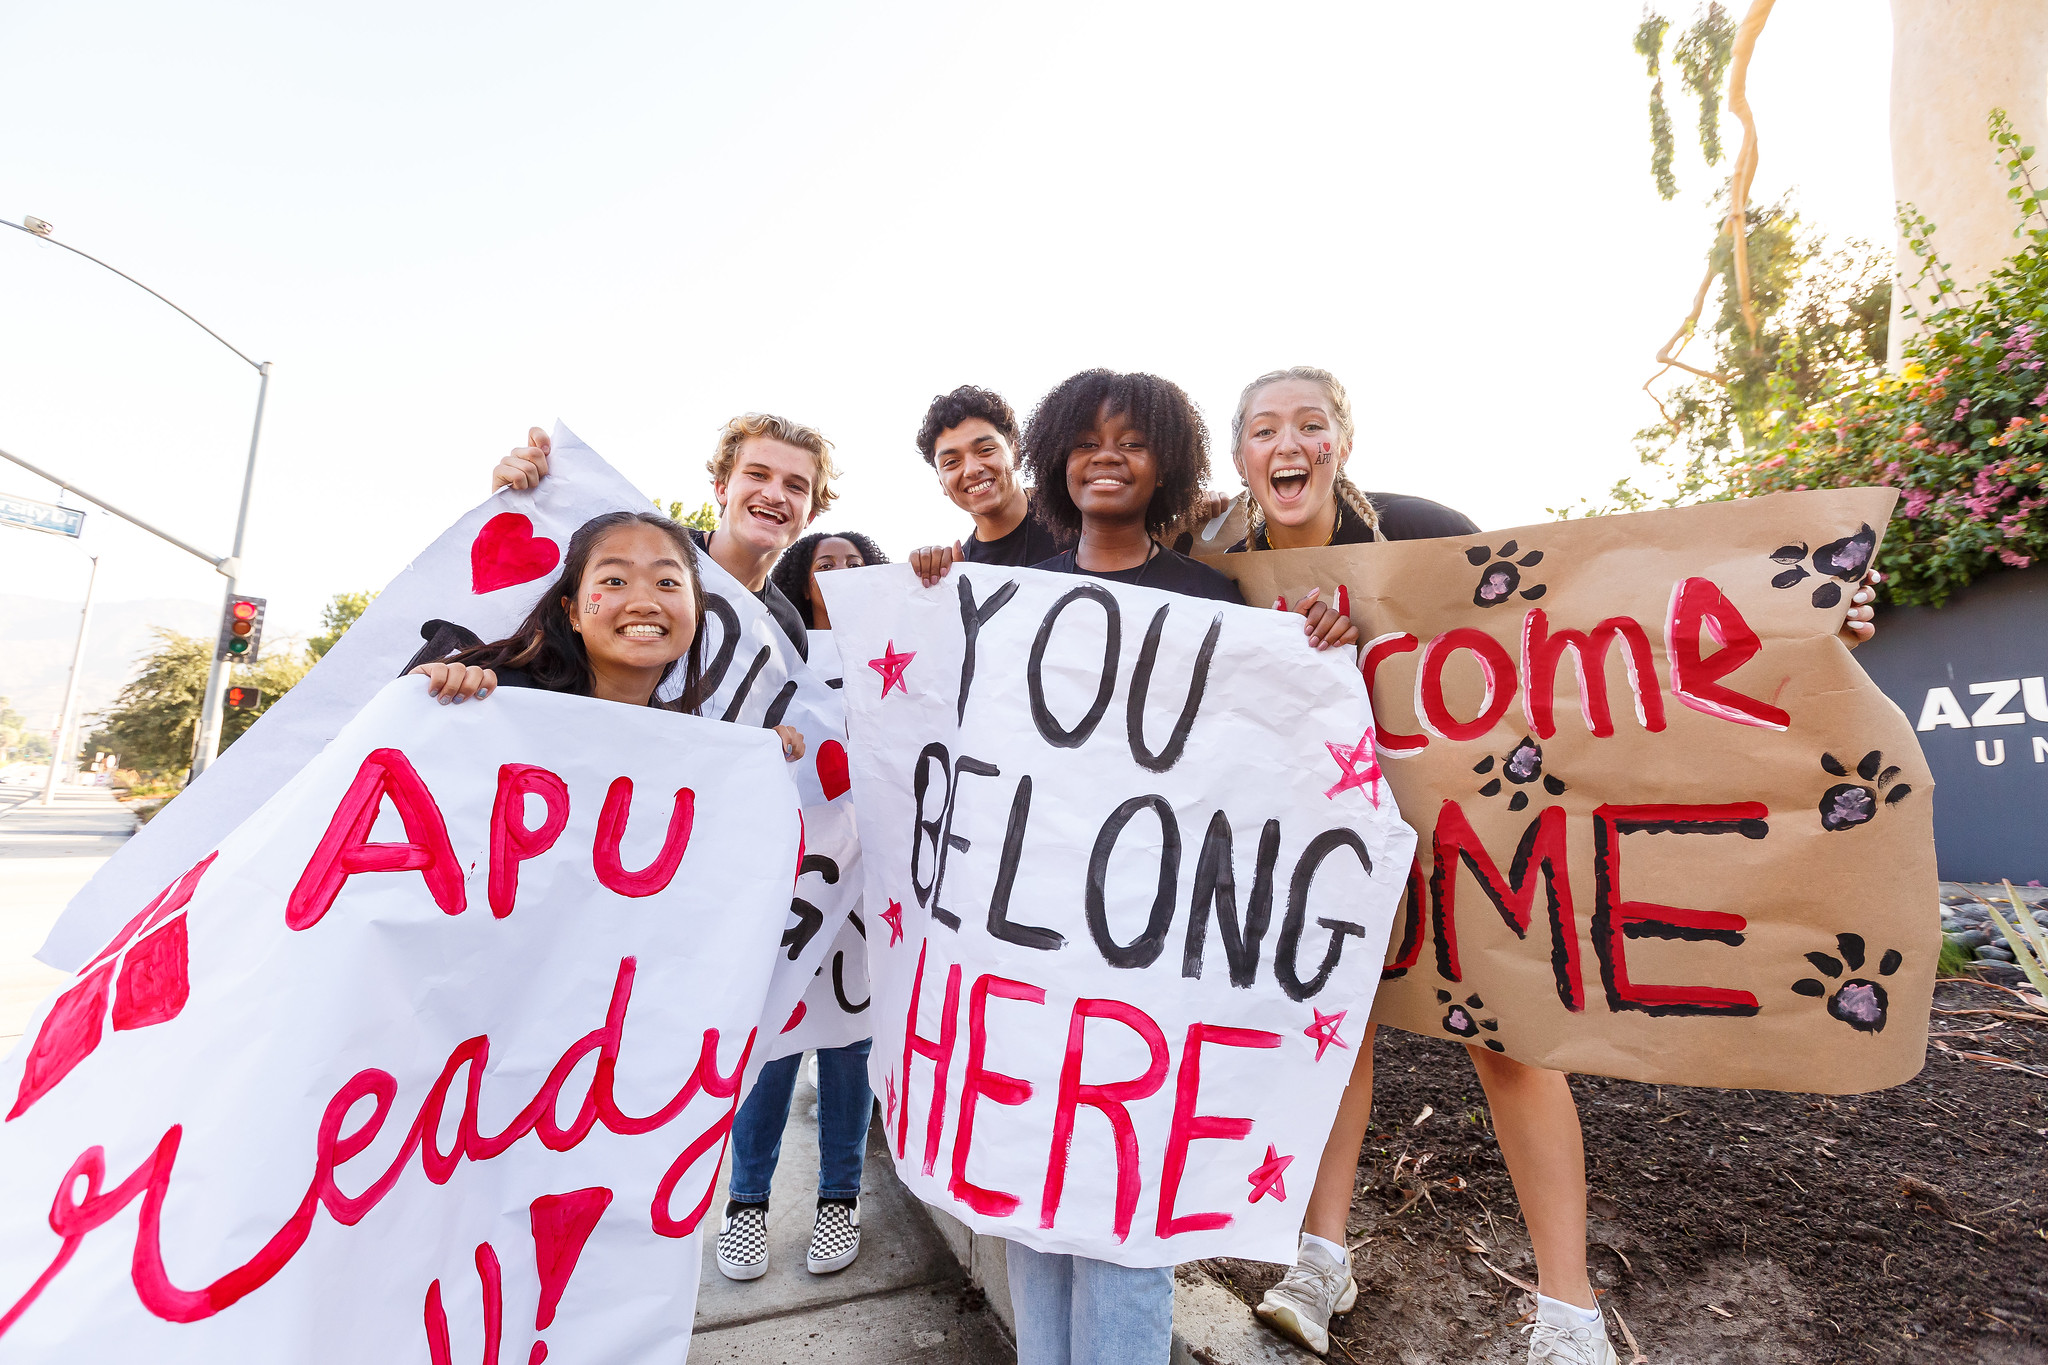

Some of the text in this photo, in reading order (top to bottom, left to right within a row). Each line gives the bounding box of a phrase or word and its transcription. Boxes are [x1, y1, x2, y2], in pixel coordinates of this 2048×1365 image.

[51, 509, 80, 526] Dr
[1314, 453, 1332, 465] APU
[584, 603, 600, 615] APU
[957, 574, 1224, 773] YOU
[1272, 577, 1791, 760] come
[285, 747, 695, 931] APU
[912, 741, 1373, 1002] BELONG
[0, 955, 758, 1339] ready
[896, 938, 1283, 1246] HERE
